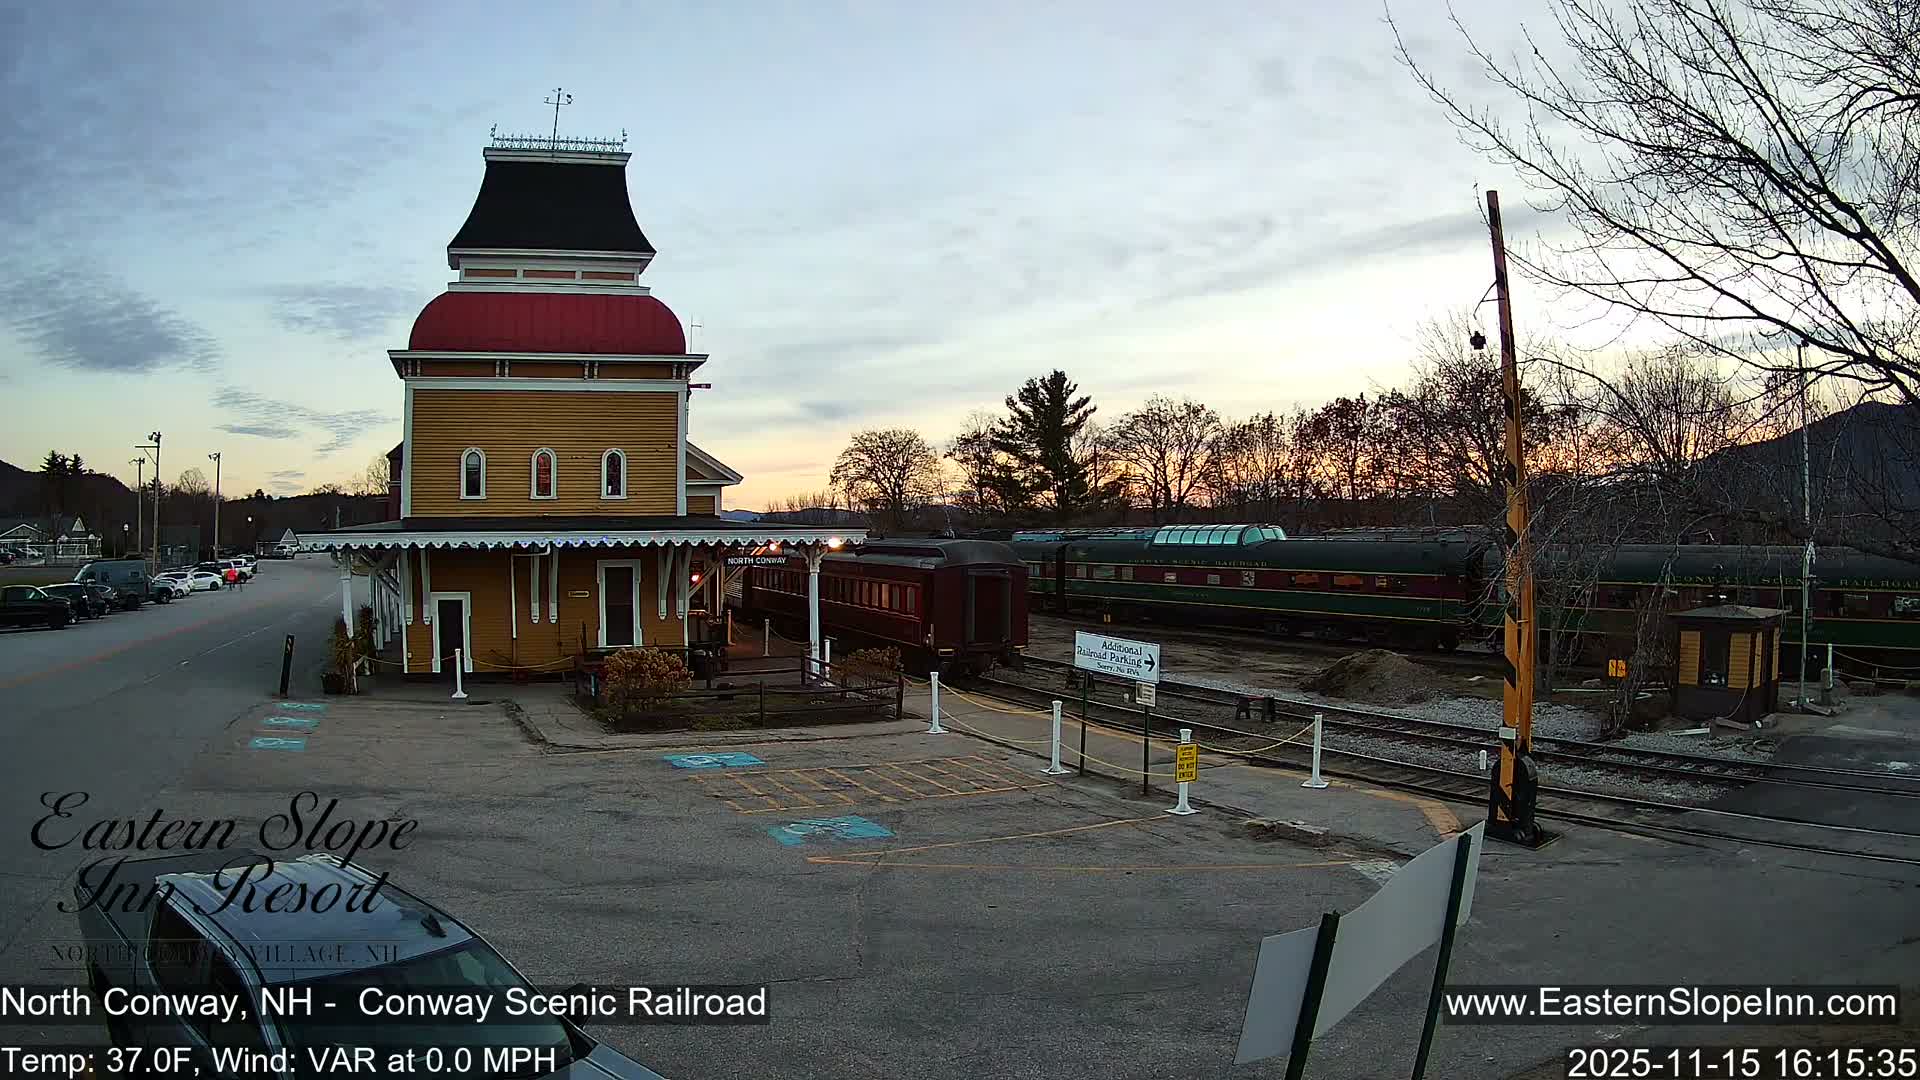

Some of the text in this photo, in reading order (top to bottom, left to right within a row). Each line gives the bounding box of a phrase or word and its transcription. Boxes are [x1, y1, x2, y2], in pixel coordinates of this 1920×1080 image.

[727, 556, 787, 565] NORTH CONWAY
[1101, 640, 1143, 656] Additional
[1076, 645, 1143, 669] Railroad Parking
